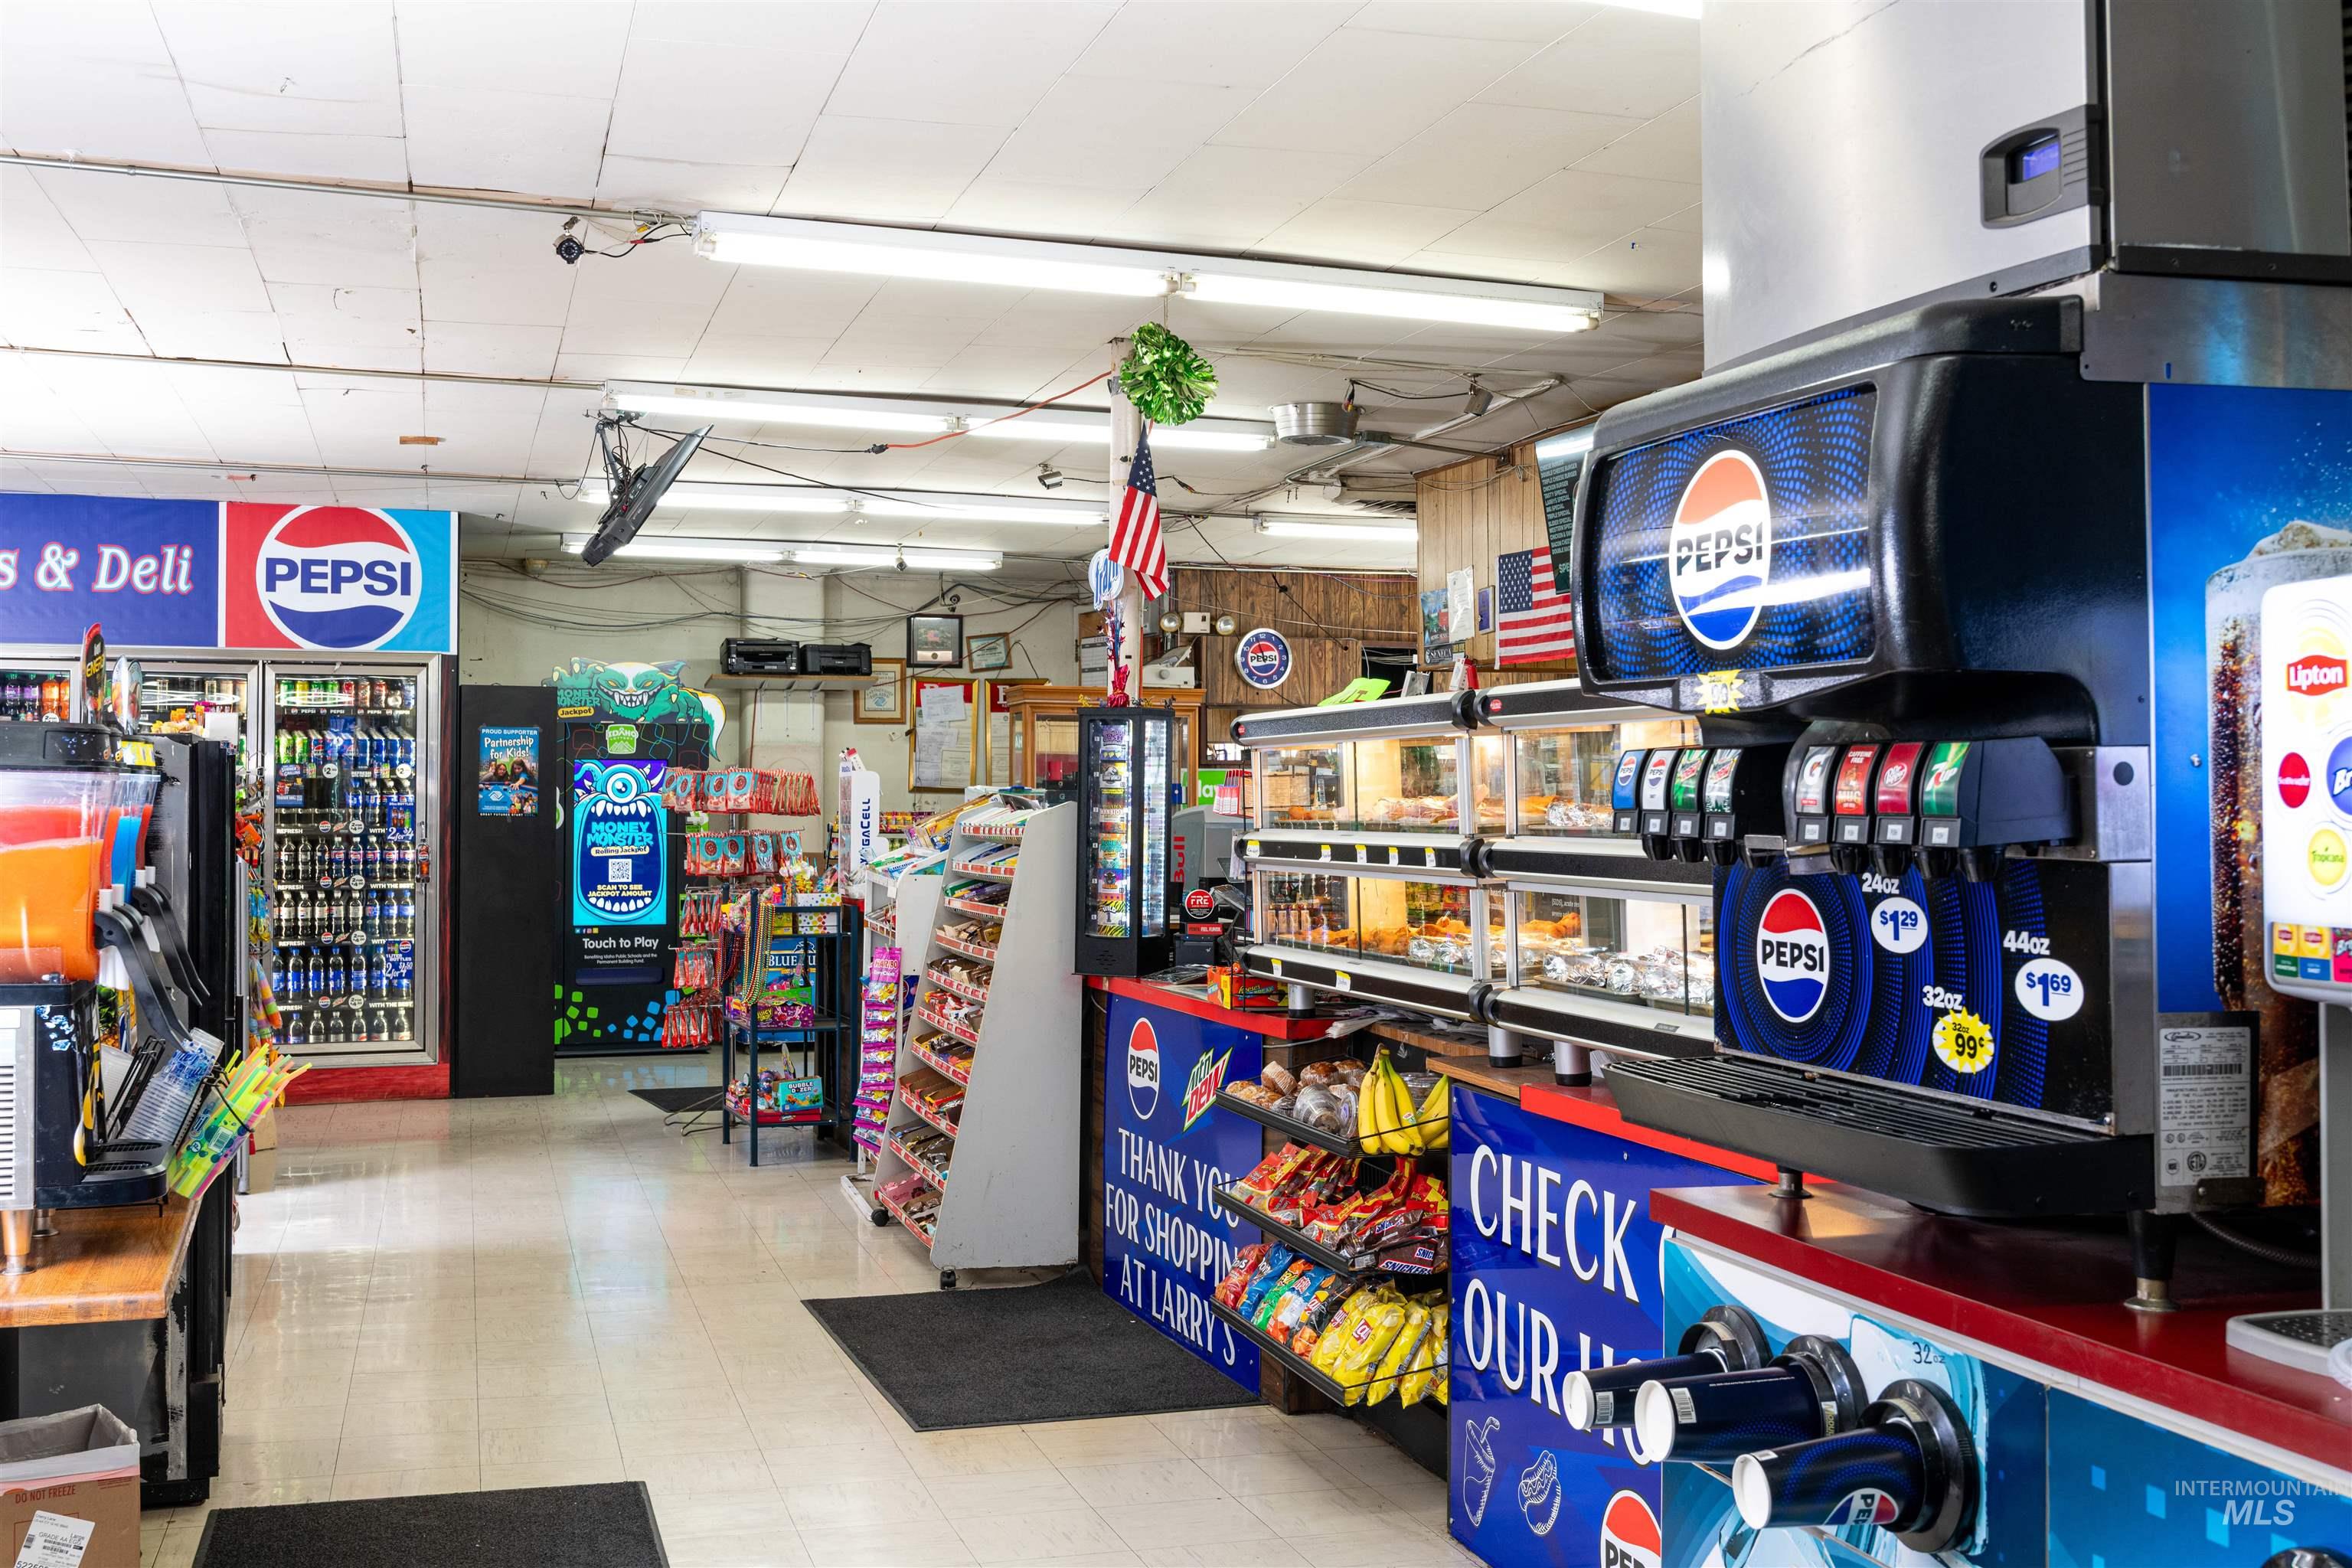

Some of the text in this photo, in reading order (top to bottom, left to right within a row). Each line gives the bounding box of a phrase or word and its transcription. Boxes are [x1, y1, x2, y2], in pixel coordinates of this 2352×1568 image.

[1675, 521, 1763, 577] PEPSI
[34, 541, 79, 592] &
[91, 544, 194, 596] Deli
[265, 557, 412, 596] PEPSI
[1430, 648, 1452, 658] SENECA
[2288, 662, 2344, 688] Lipton
[560, 707, 592, 717] Jackpot
[609, 728, 639, 737] IDAHO
[484, 735, 534, 748] Partnership
[490, 746, 529, 760] for Kids!
[1803, 754, 1830, 786] G
[1838, 791, 1861, 802] MUG
[387, 828, 396, 841] 2
[403, 828, 414, 840] $4
[591, 822, 649, 834] MONEY
[586, 831, 654, 847] MONSTER
[620, 845, 647, 854] Jackpot
[2312, 847, 2345, 863] Tropicana
[1861, 872, 1900, 894] 24oz
[1191, 895, 1210, 905] FRE
[583, 936, 659, 949] Touch to Play
[2003, 930, 2050, 956] 44oz
[769, 955, 796, 966] BLUE
[1761, 938, 1824, 972] PEPSI
[385, 962, 393, 976] 2
[874, 959, 898, 969] HARIBO
[1922, 985, 1963, 1010] 32oz
[1952, 1022, 1970, 1034] 32oz
[1129, 1054, 1160, 1083] PEPSI
[788, 1081, 814, 1089] BUBBLE
[1119, 1127, 1240, 1229] THANK YOU
[1106, 1182, 1139, 1245] FOR
[1470, 1144, 1639, 1303] CHECK
[1120, 1254, 1146, 1304] AT
[1463, 1278, 1562, 1416] OUR
[15, 1485, 77, 1504] DO NOT FREEZE
[38, 1531, 59, 1541] GRADE
[70, 1533, 85, 1543] Large
